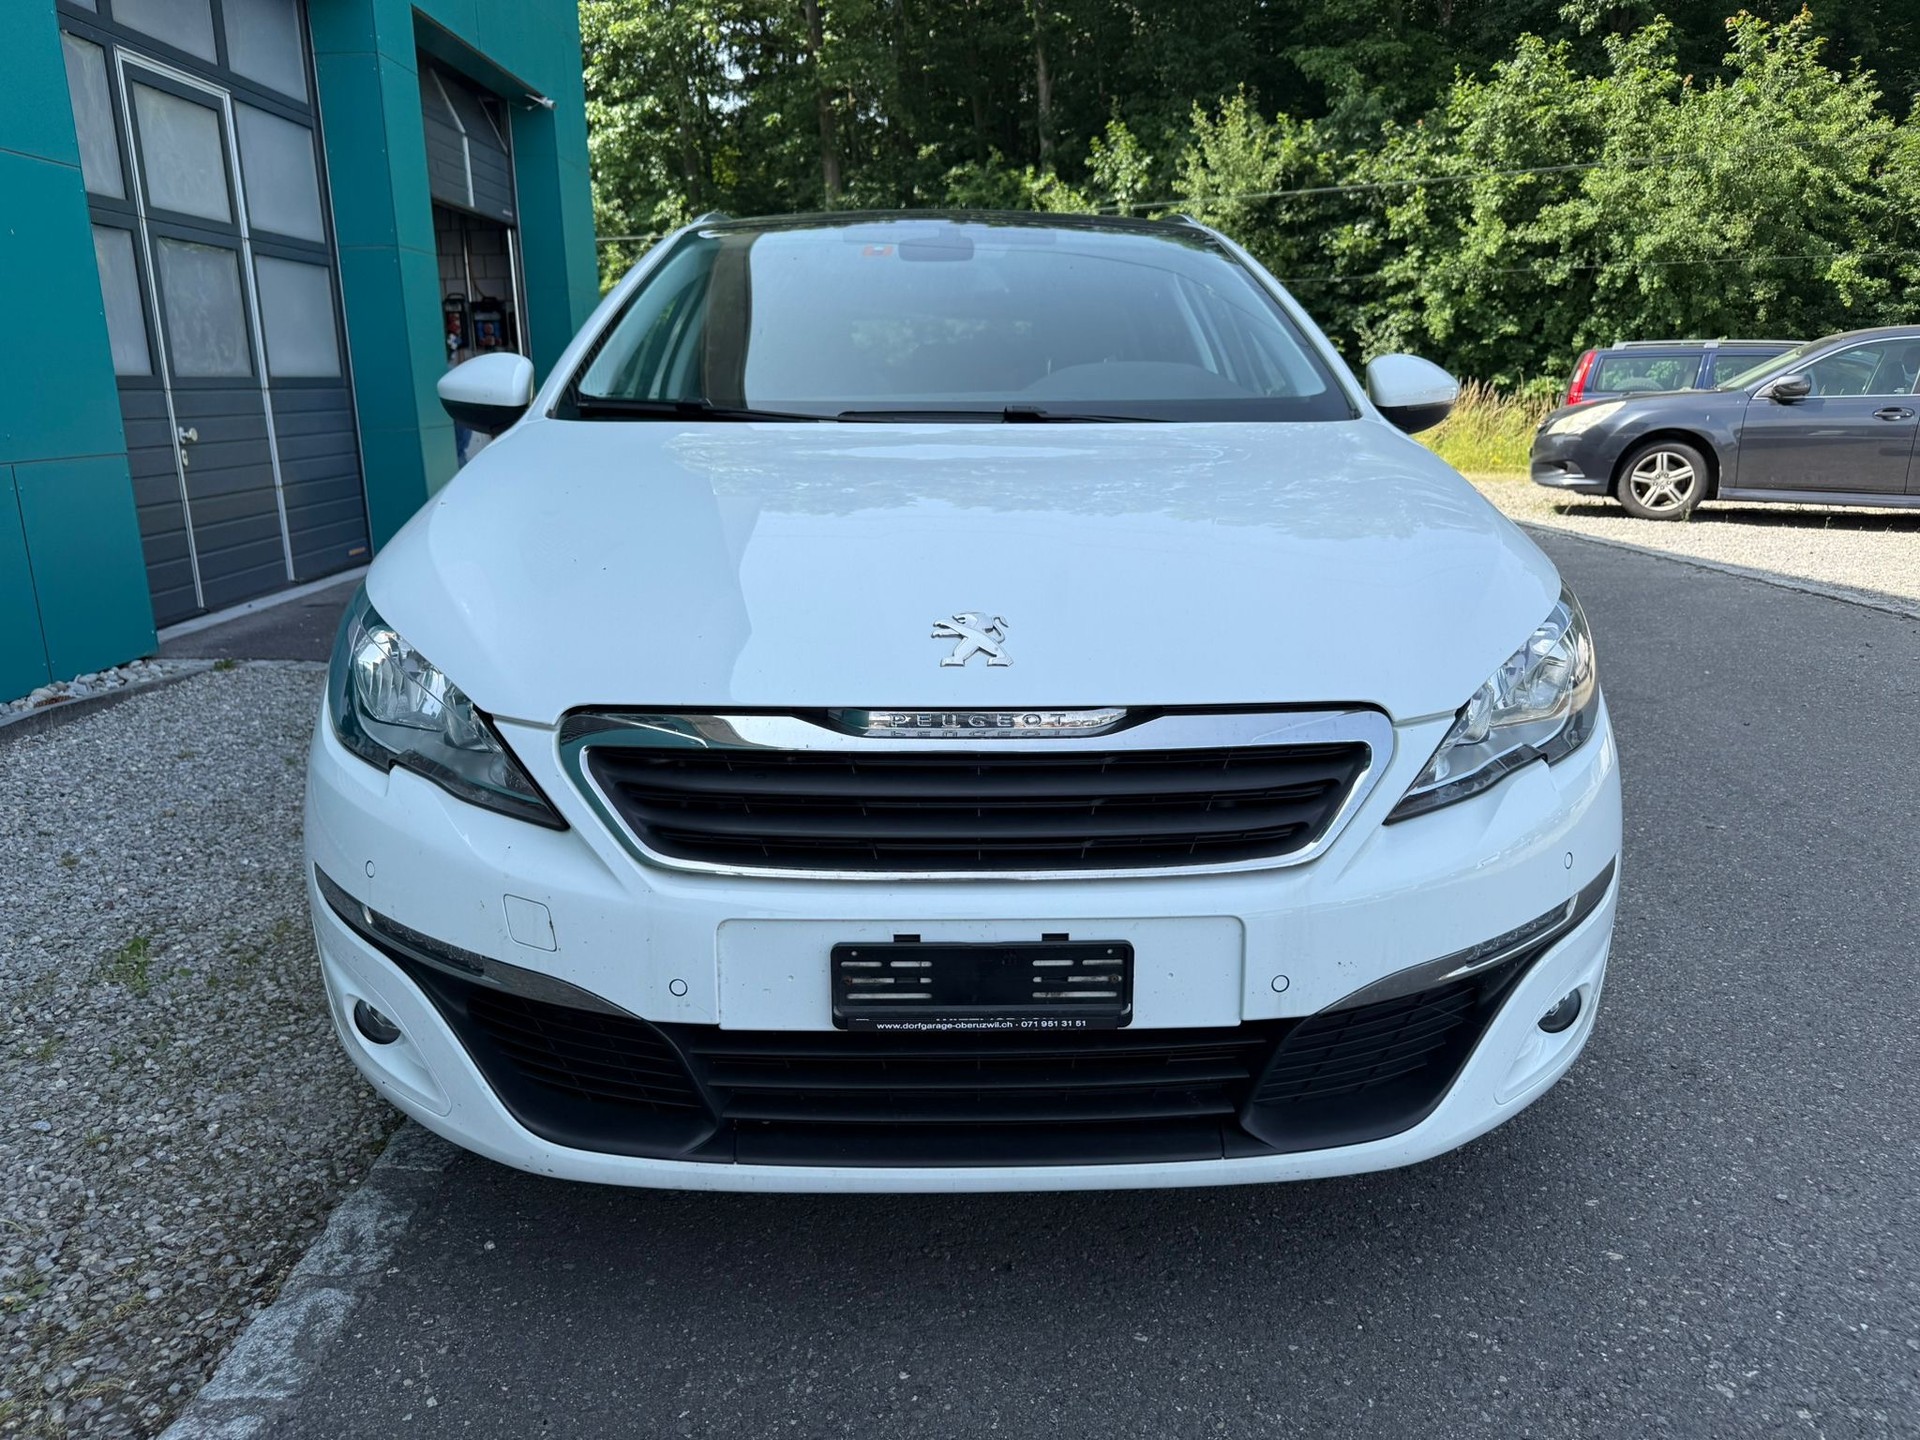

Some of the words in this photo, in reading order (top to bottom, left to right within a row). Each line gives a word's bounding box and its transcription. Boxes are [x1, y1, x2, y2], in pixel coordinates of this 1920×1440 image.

[889, 712, 1067, 728] PEUGEOT
[876, 1021, 1013, 1030] www.dorfgarage-oberuzwil.ch
[1020, 1020, 1038, 1028] 071
[1041, 1020, 1058, 1028] 951
